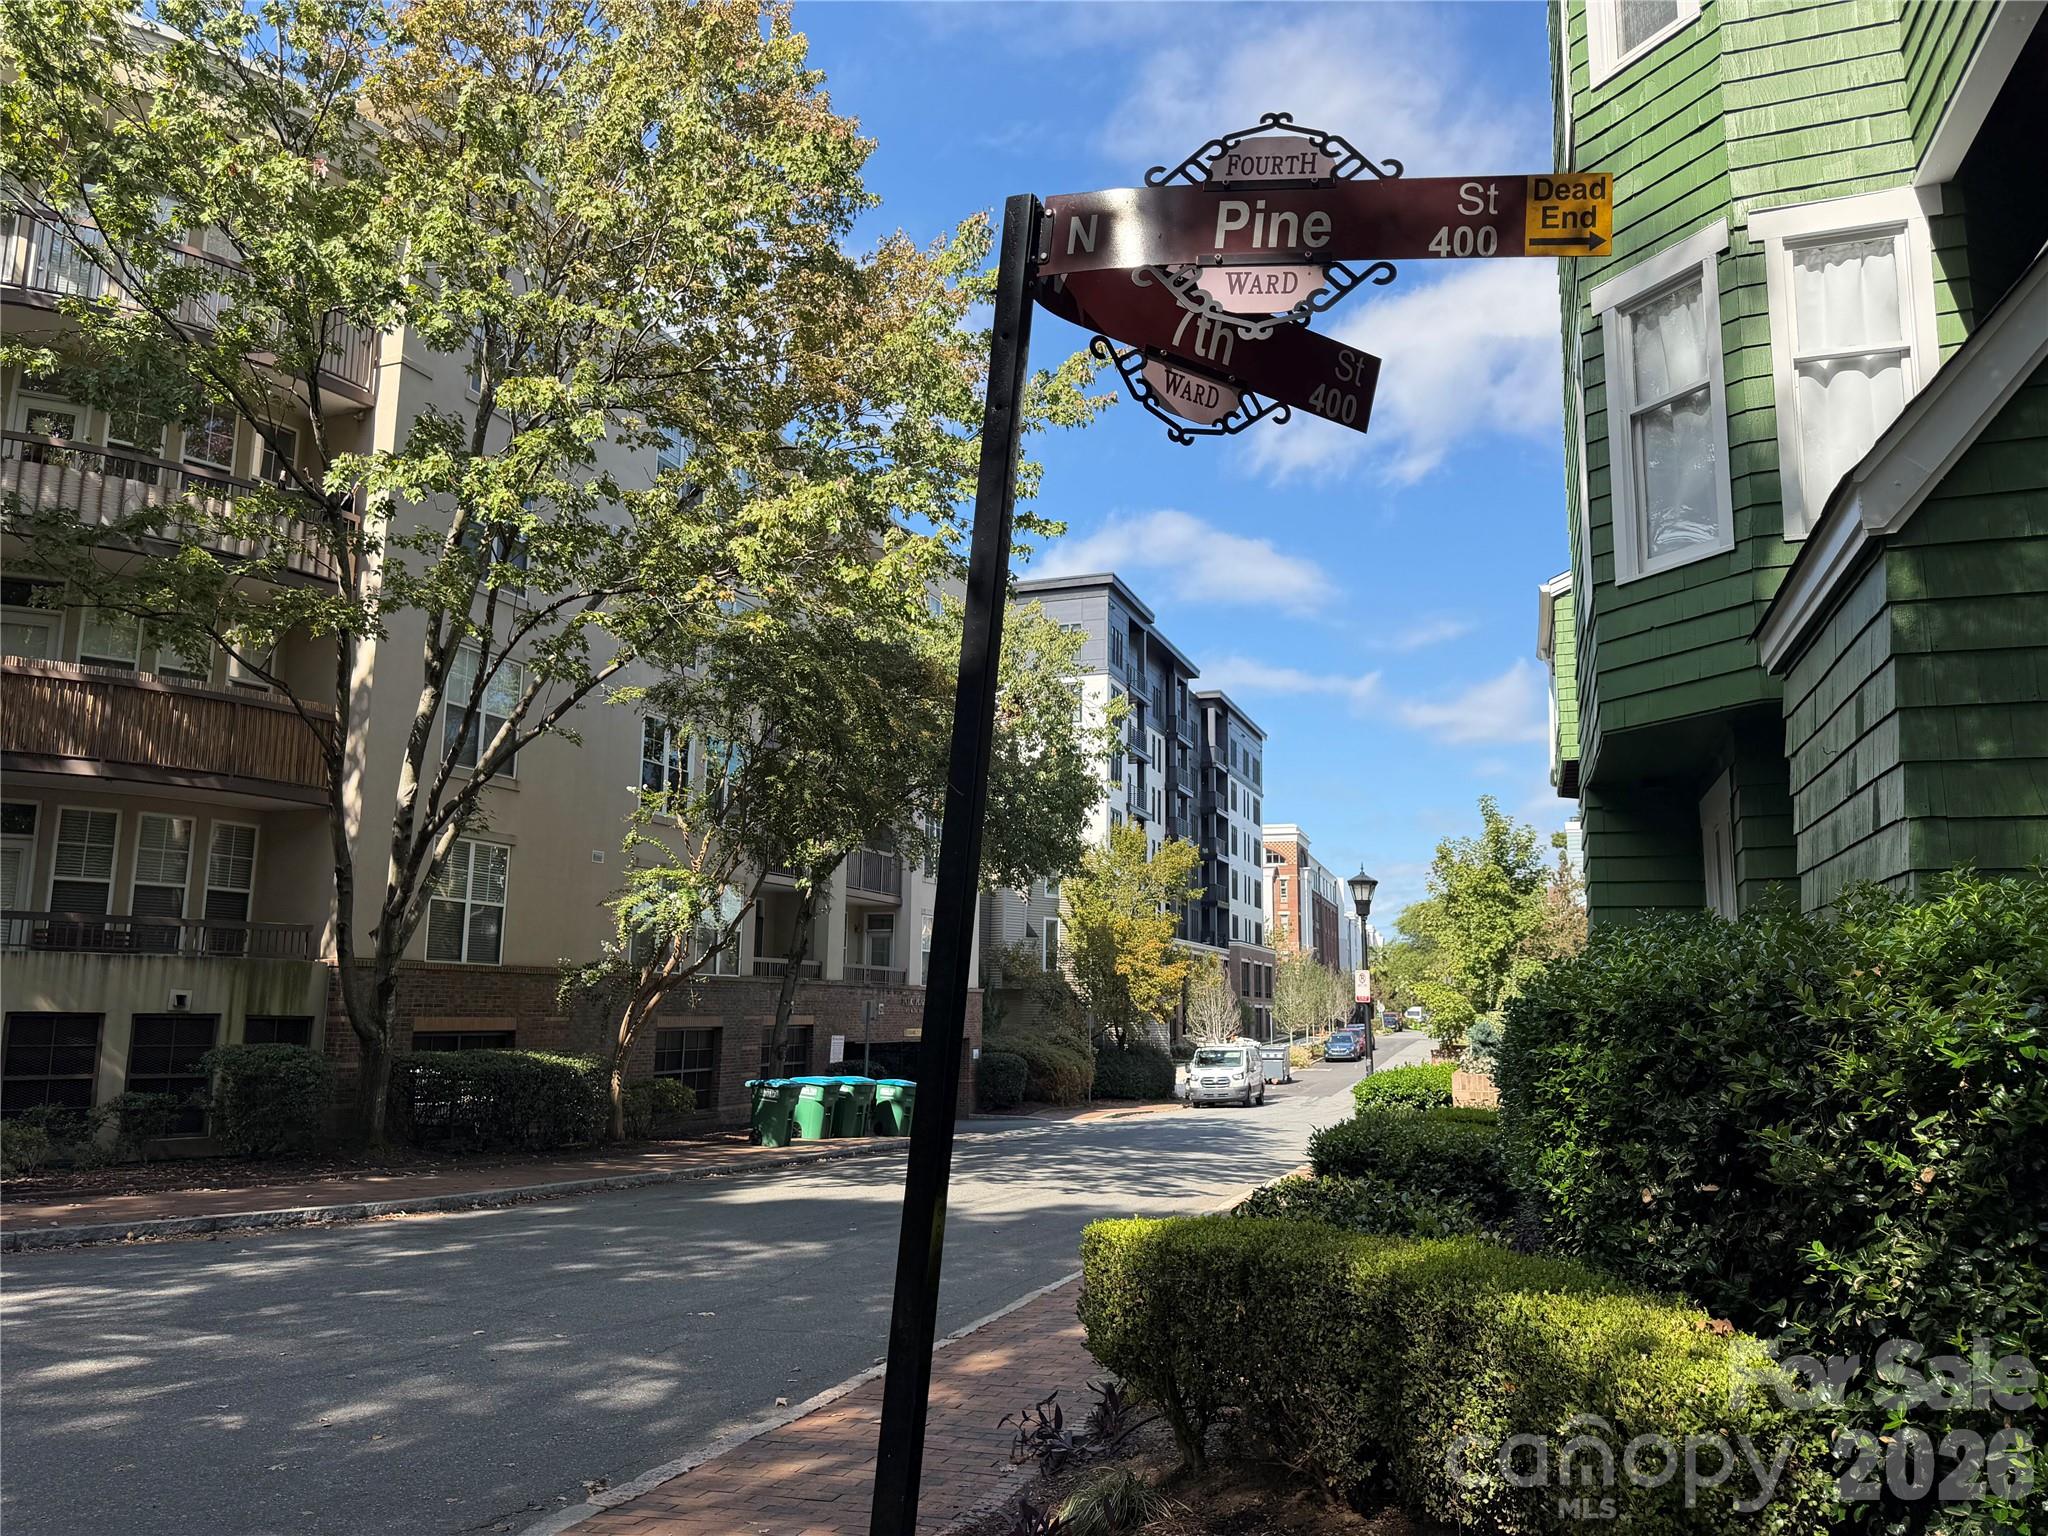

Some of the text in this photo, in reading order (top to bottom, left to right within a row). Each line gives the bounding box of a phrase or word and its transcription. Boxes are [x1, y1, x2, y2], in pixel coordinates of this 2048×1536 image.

[1225, 152, 1318, 176] FOURTH
[1457, 182, 1499, 216] St
[1534, 176, 1606, 201] Dead
[1067, 199, 1332, 255] N Pine
[1541, 205, 1597, 229] End
[1428, 225, 1498, 258] 400
[1225, 271, 1299, 295] WARD
[1171, 300, 1235, 366] 7th
[1335, 350, 1365, 387] St
[1164, 369, 1219, 409] WARD
[1308, 383, 1357, 425] 400
